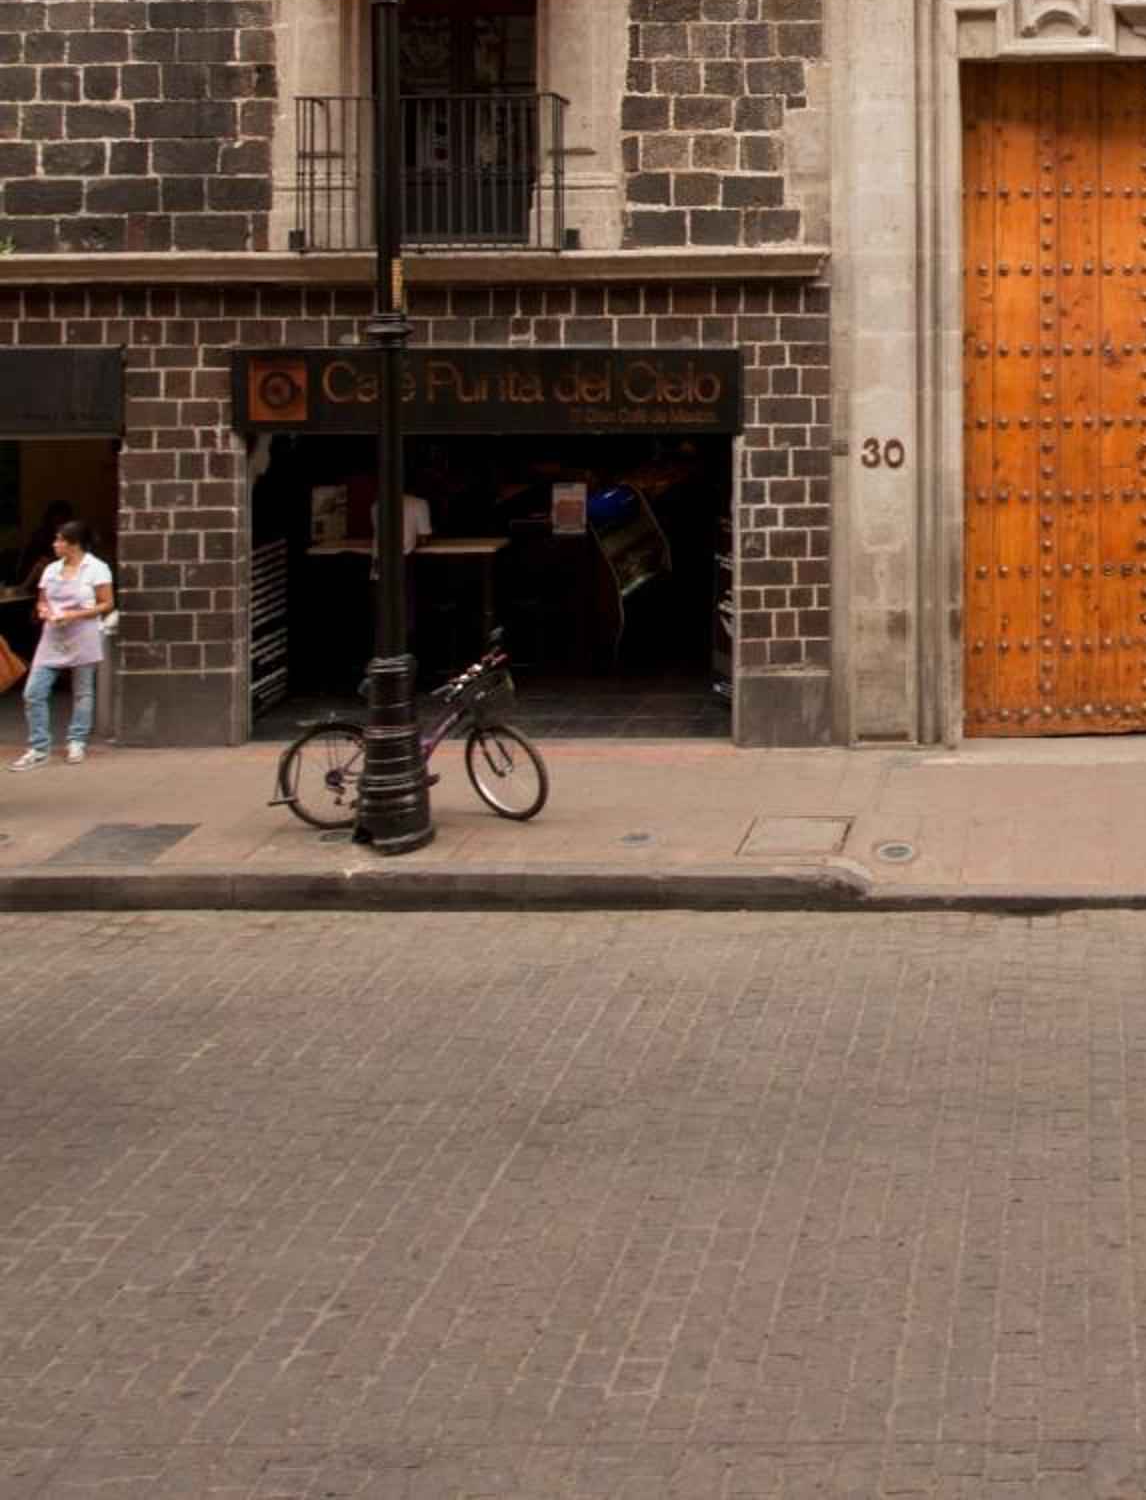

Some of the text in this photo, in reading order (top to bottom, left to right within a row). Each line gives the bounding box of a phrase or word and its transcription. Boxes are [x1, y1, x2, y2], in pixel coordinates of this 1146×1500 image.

[322, 359, 721, 403] Caé Punta del Cielo
[862, 437, 905, 469] 30
